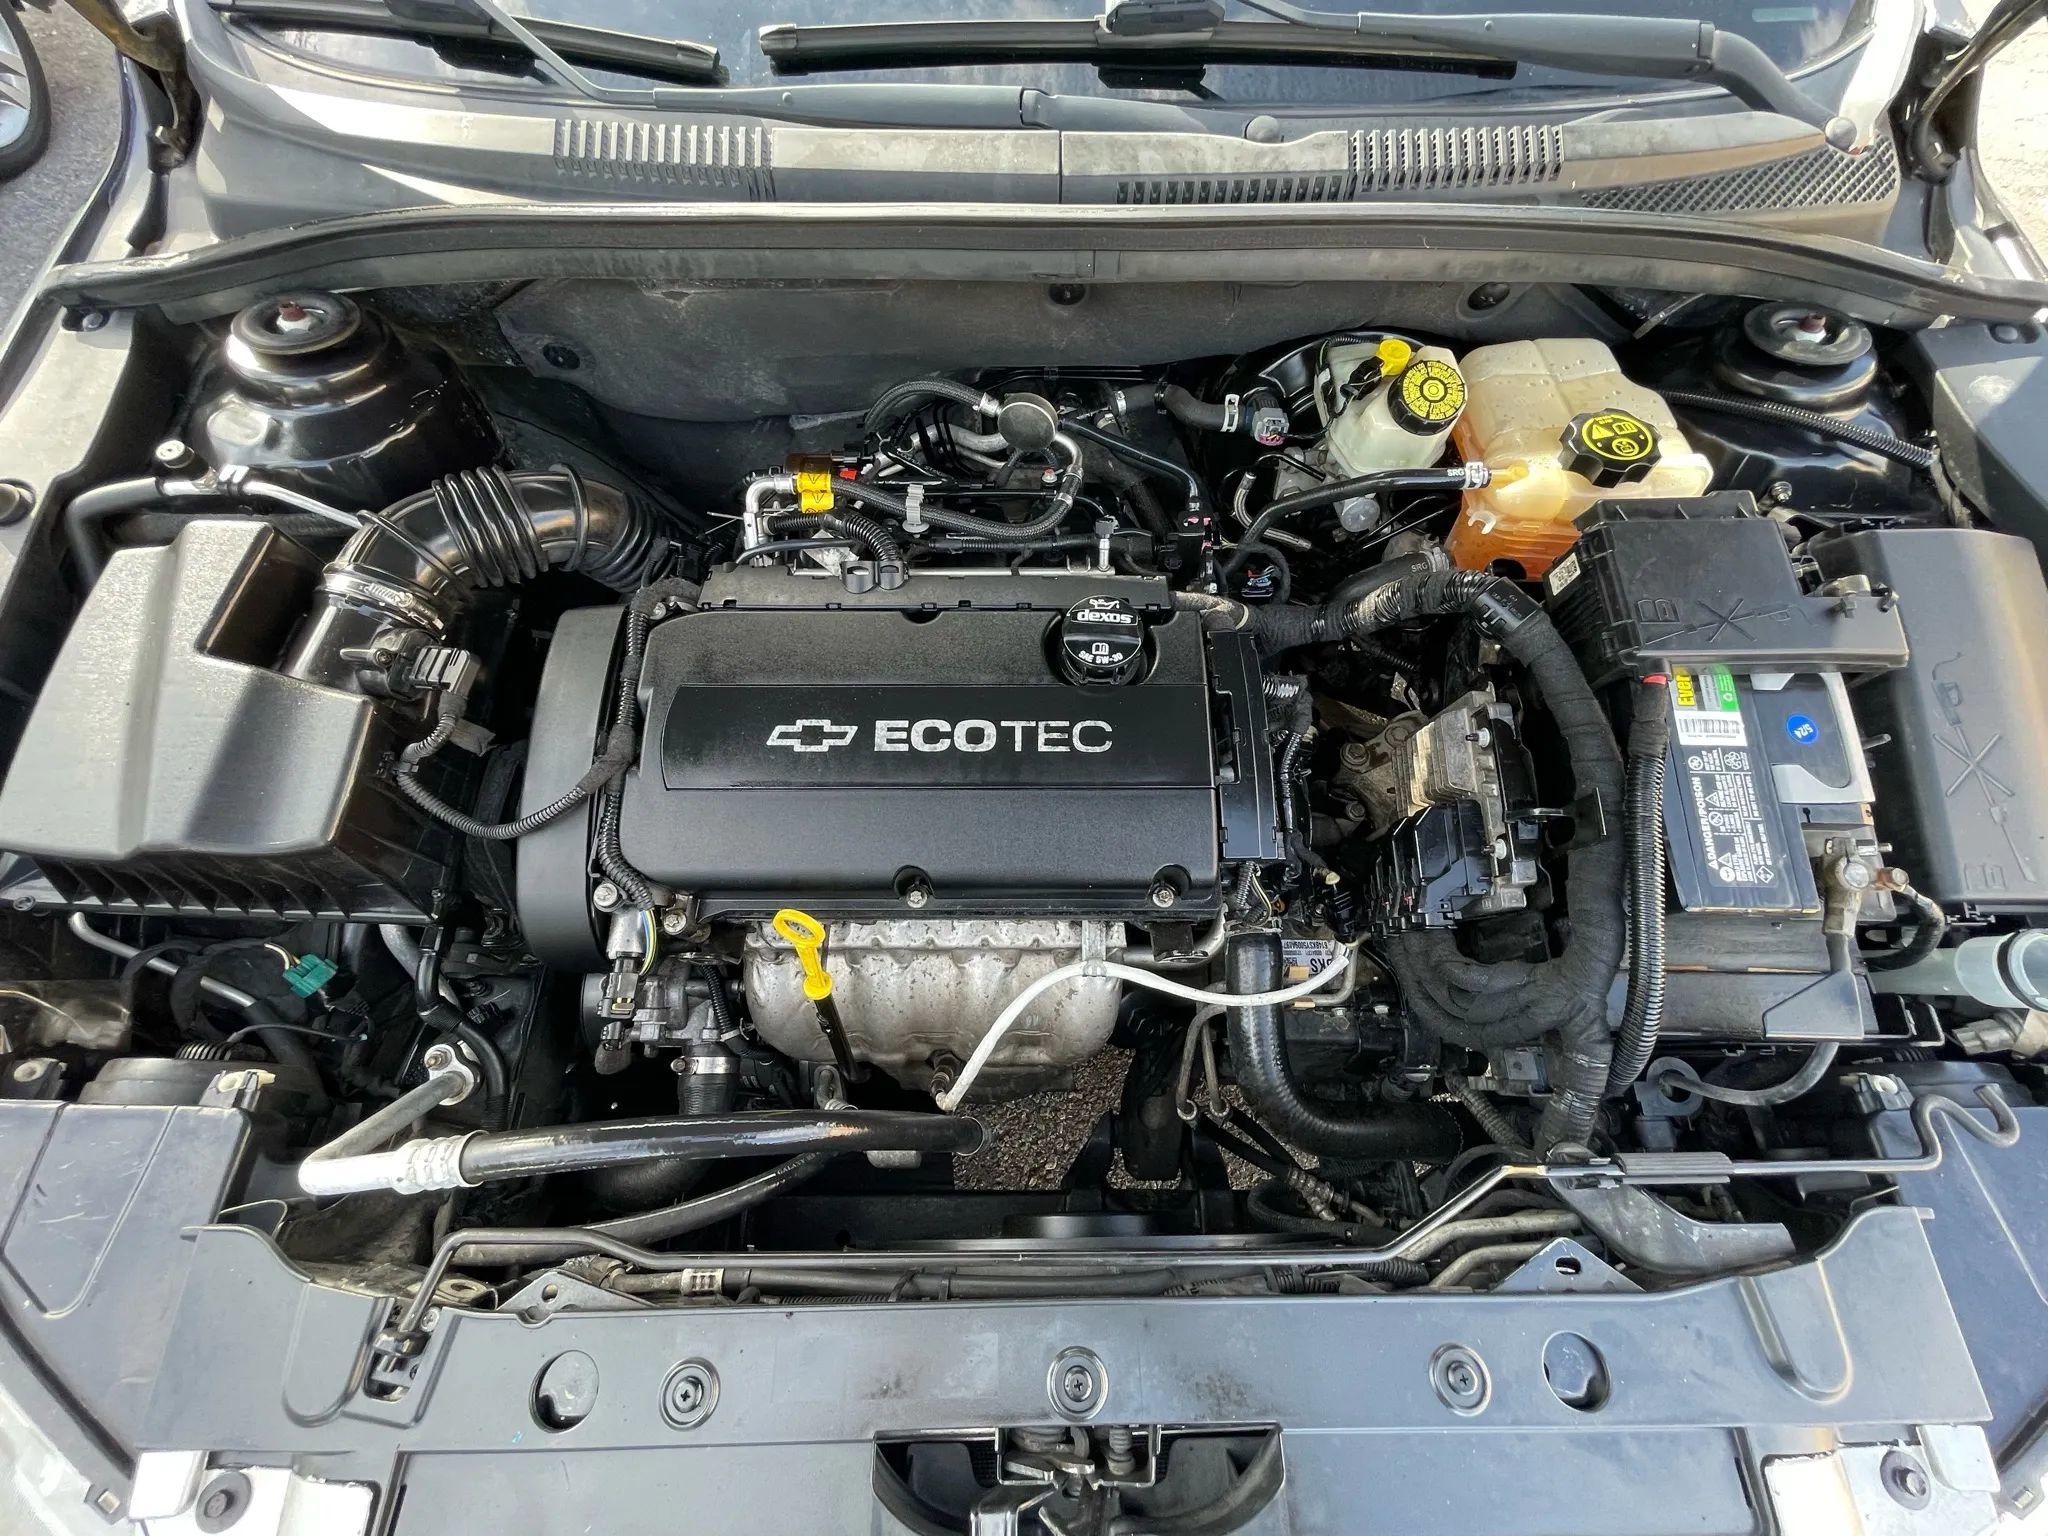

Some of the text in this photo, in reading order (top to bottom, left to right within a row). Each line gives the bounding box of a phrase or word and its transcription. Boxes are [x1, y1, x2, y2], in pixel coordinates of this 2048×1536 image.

[1447, 468, 1464, 477] SRG
[1411, 561, 1428, 572] SRG
[1077, 609, 1133, 624] dexos
[1078, 650, 1123, 664] SAE 5W-30
[874, 719, 1113, 752] ECOTEC
[1691, 776, 1716, 860] DANGER/POISON
